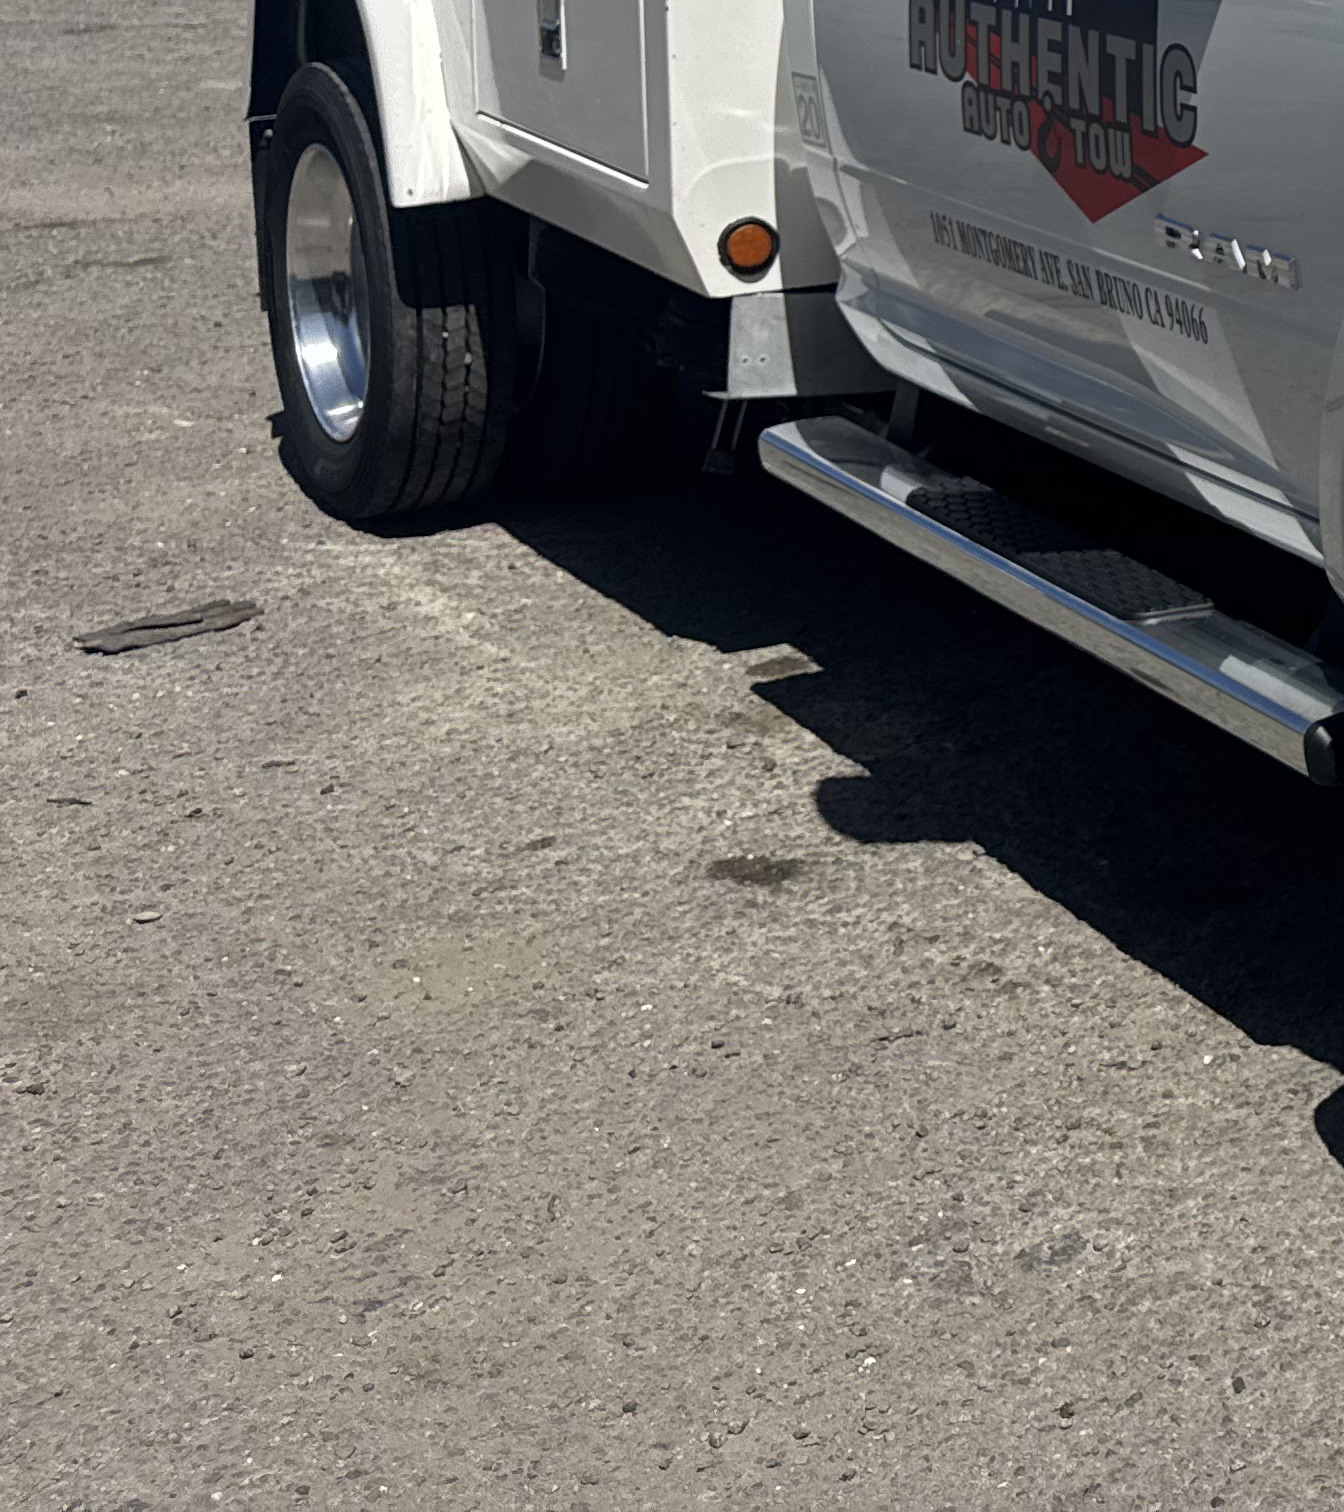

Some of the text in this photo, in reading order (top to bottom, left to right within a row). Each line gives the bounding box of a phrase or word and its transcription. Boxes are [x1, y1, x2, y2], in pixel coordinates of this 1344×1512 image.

[961, 80, 1133, 181] AUTO TOW
[929, 208, 958, 250] 1051
[956, 218, 1039, 280] MONTGOMERY
[1066, 259, 1096, 301] SAN
[1095, 269, 1144, 320] BRUNO
[1145, 287, 1167, 328] CA
[1164, 294, 1209, 345] 94066
[1154, 213, 1298, 291] RAM
